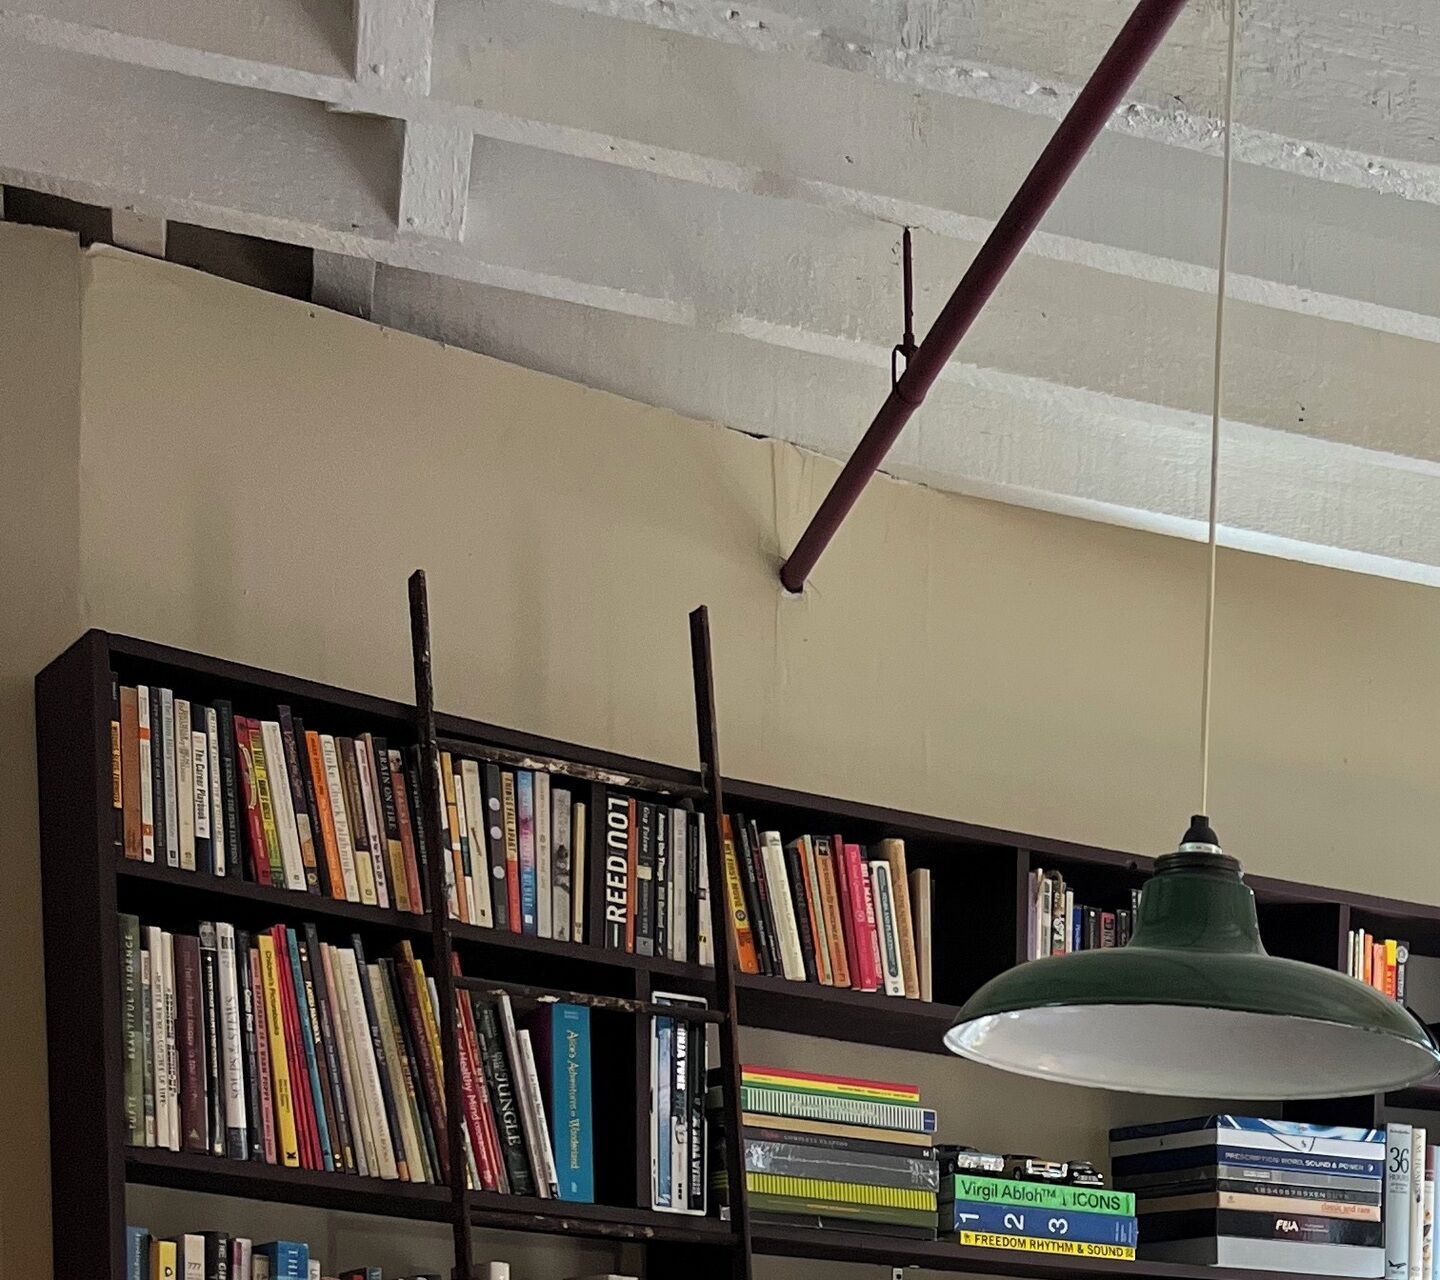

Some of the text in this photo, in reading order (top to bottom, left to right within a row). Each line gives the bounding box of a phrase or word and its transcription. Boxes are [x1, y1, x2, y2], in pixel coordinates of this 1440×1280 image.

[195, 749, 206, 820] The Career Playbook
[379, 750, 396, 830] BRAIN ON FIRE
[324, 741, 351, 874] Choke Chuck Palahniuk
[507, 827, 517, 852] APART
[606, 797, 629, 924] LOU REED
[725, 858, 736, 882] FIRST
[458, 1052, 472, 1092] Healthy
[467, 1094, 481, 1121] Mind
[494, 1072, 521, 1146] JUNGLE
[1305, 1159, 1331, 1168] SOUND
[1338, 1162, 1364, 1170] POWER
[1389, 1147, 1408, 1173] 36
[961, 1180, 998, 1200] Virgil
[1072, 1192, 1121, 1211] ICONS
[959, 1212, 1068, 1234] 1 2 3
[218, 1239, 226, 1258] THE
[974, 1234, 1124, 1258] FREEDOM RHYTHM & SOUND
